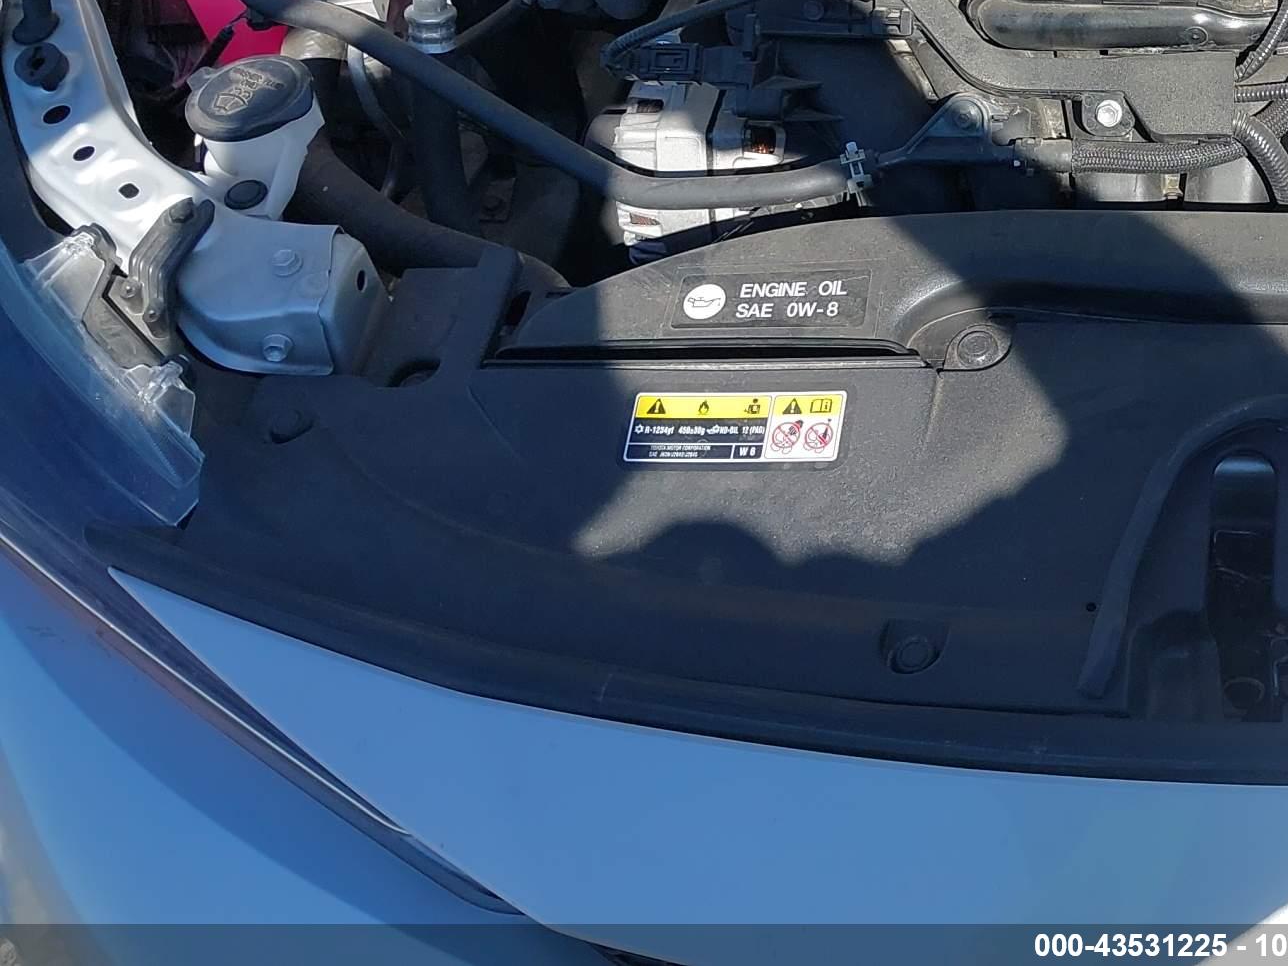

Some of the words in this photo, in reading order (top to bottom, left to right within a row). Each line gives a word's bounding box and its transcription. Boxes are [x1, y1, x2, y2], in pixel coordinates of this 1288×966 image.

[739, 281, 808, 299] ENGINE
[818, 280, 848, 296] OIL
[735, 303, 774, 318] SAE
[786, 302, 839, 318] 0W-8
[739, 447, 748, 456] W
